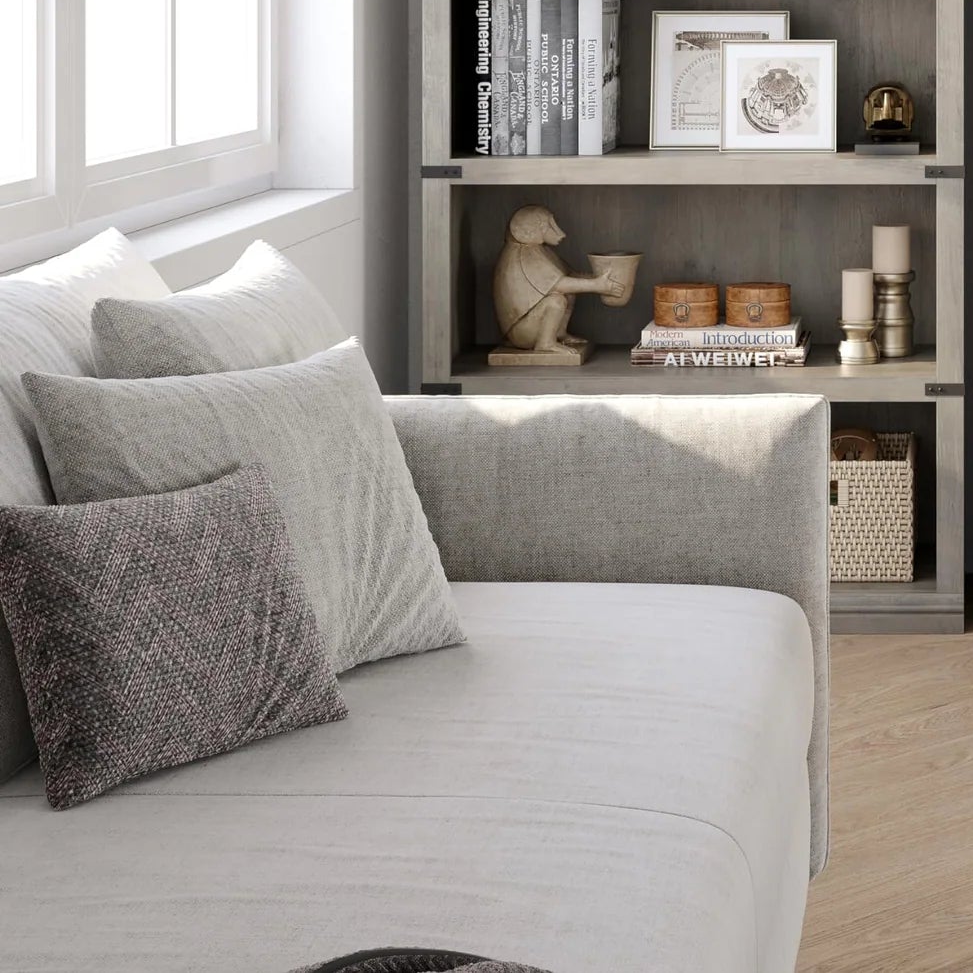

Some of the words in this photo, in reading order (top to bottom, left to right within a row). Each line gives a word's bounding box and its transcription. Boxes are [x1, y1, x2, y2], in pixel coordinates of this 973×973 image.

[566, 38, 575, 79] Forming
[586, 39, 598, 78] Forming
[551, 55, 559, 106] ONTARIO
[475, 81, 492, 154] Chemistry
[566, 89, 575, 120] Nation
[588, 89, 598, 120] Nation
[649, 330, 683, 338] Modern
[703, 331, 793, 345] Introduction
